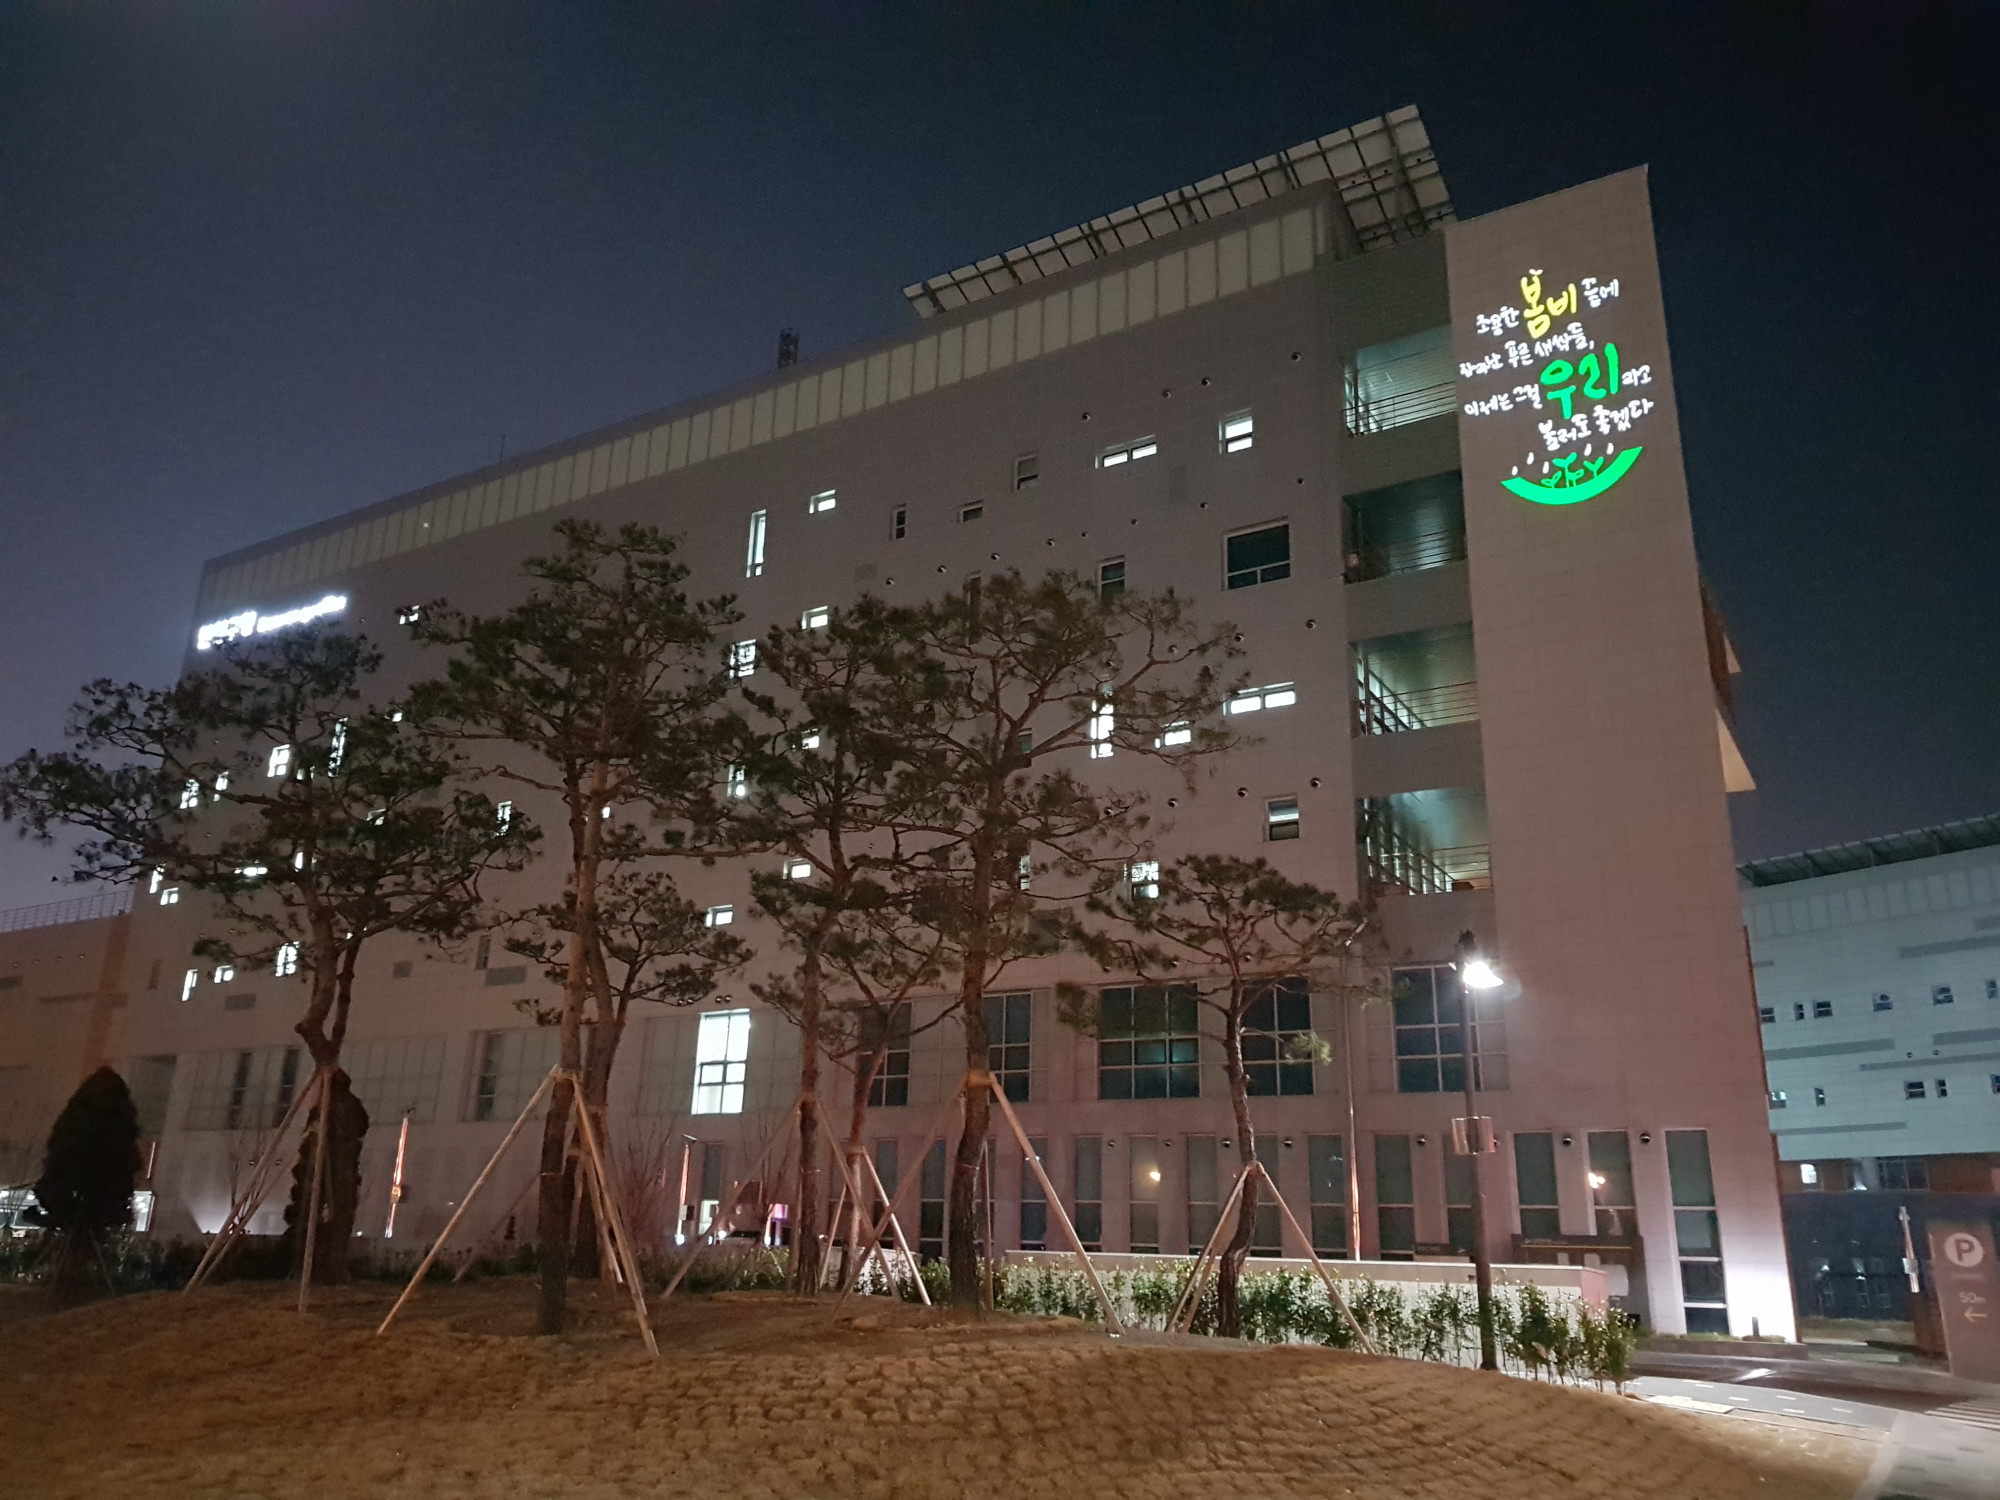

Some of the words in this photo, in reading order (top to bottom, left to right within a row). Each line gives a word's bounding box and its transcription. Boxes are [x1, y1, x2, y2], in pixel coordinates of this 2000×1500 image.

[1476, 305, 1520, 337] 조용한
[1520, 271, 1577, 339] 봄비
[1459, 352, 1504, 379] 자라난
[1503, 340, 1534, 369] 푸른
[1534, 321, 1595, 358] 새싹들,
[1463, 392, 1514, 417] 이제는
[1512, 383, 1543, 410] 그걸
[1537, 413, 1593, 452] 불러도
[1592, 397, 1655, 436] 좋겠다
[1954, 1238, 1976, 1262] P
